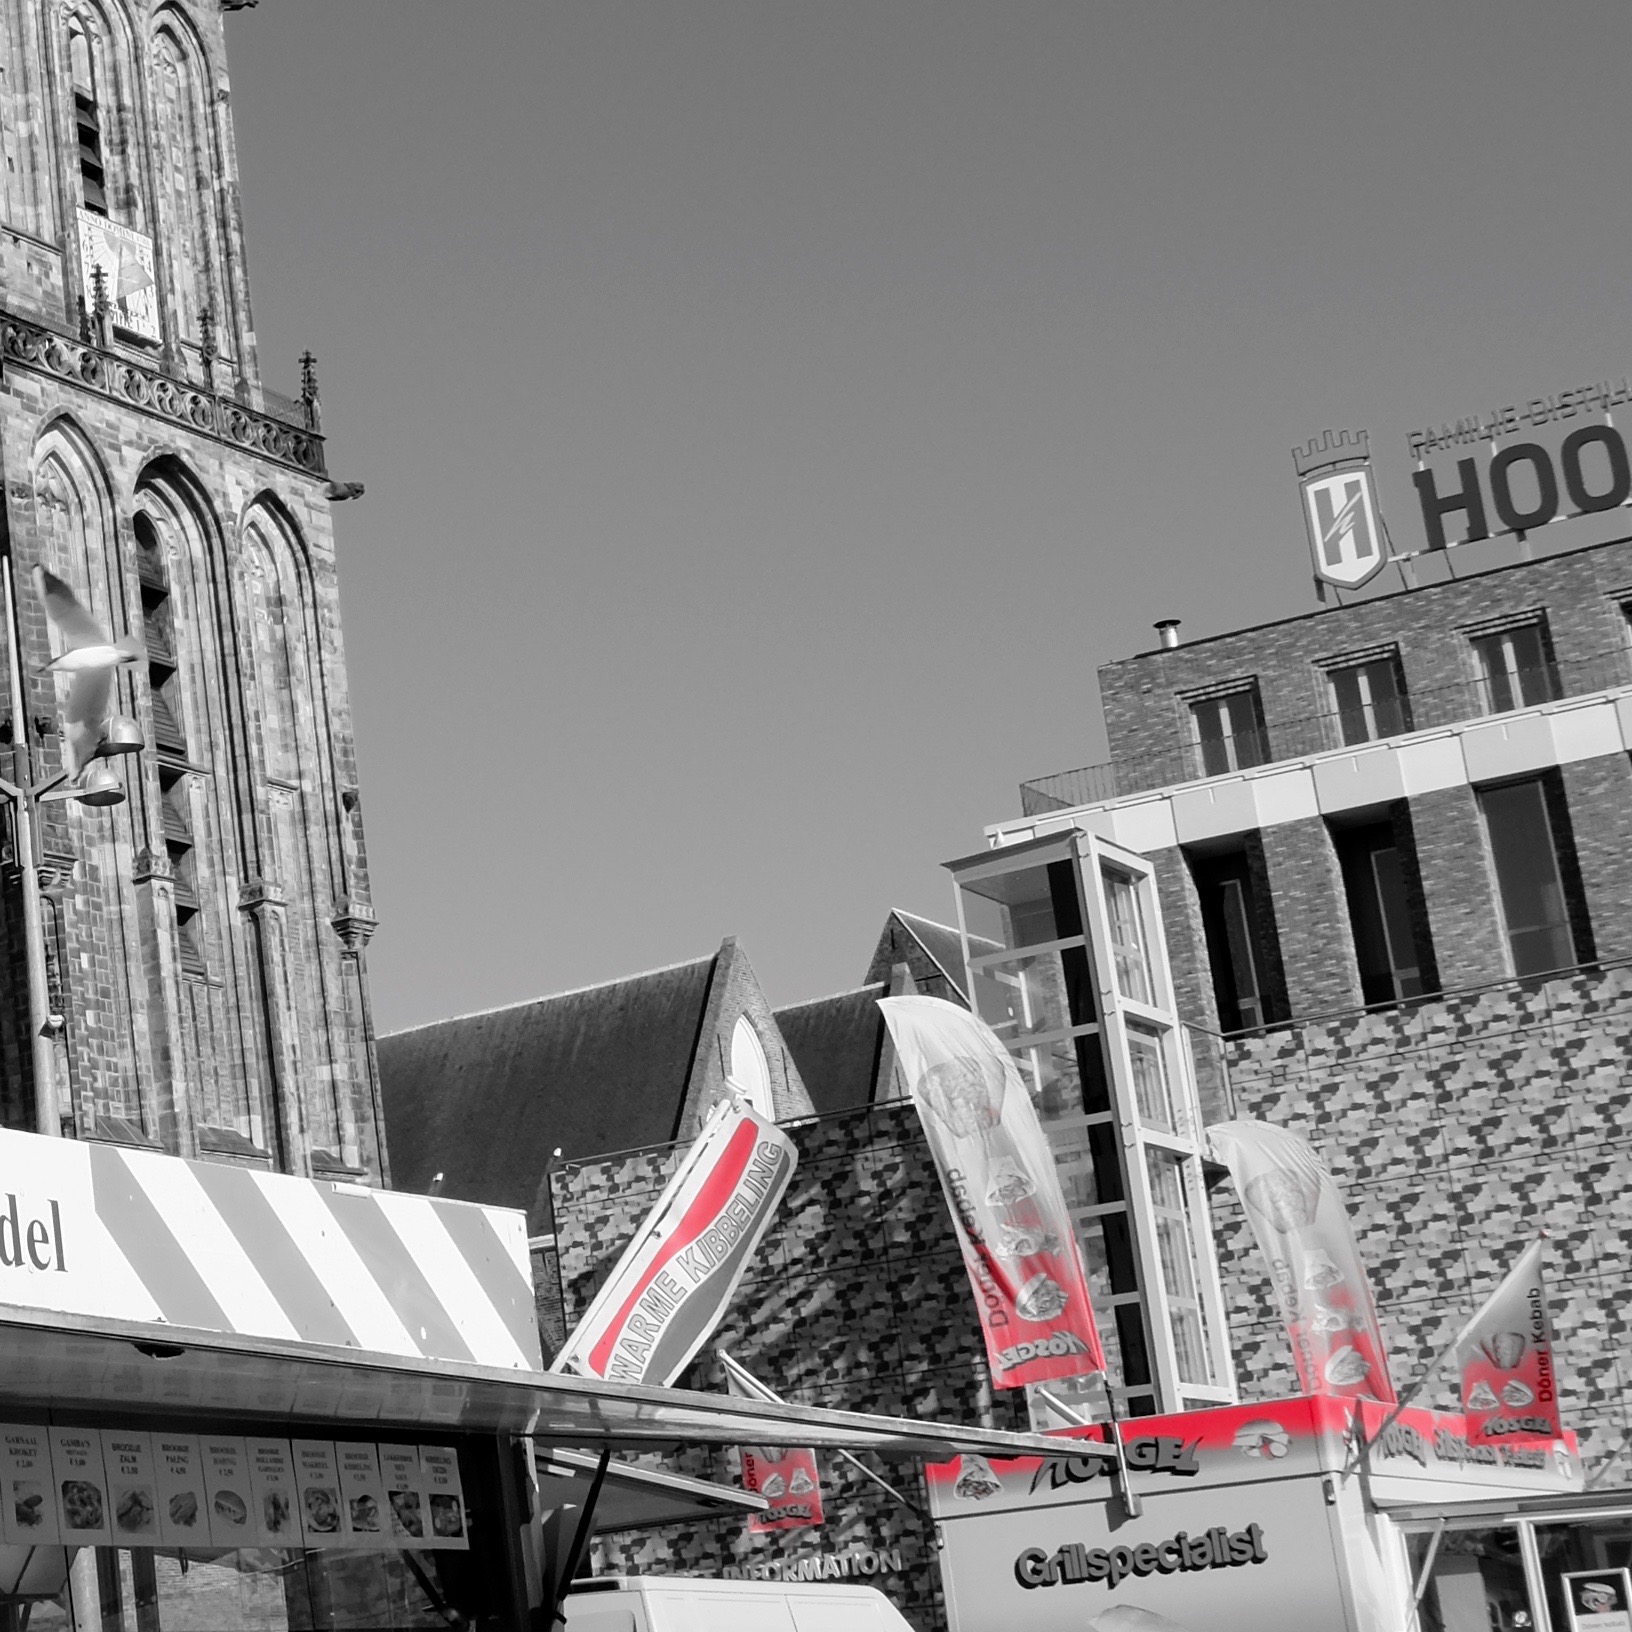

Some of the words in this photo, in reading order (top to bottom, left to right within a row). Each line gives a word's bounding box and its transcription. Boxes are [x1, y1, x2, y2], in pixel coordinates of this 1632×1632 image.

[1406, 405, 1520, 459] FAMILIE
[608, 1270, 688, 1384] WARME
[675, 1140, 783, 1284] KIBBELING
[1526, 1287, 1547, 1344] Kebab
[1535, 1349, 1552, 1403] Döner
[722, 1549, 902, 1581] INFORMATION
[1014, 1522, 1268, 1590] Grillspecialist
